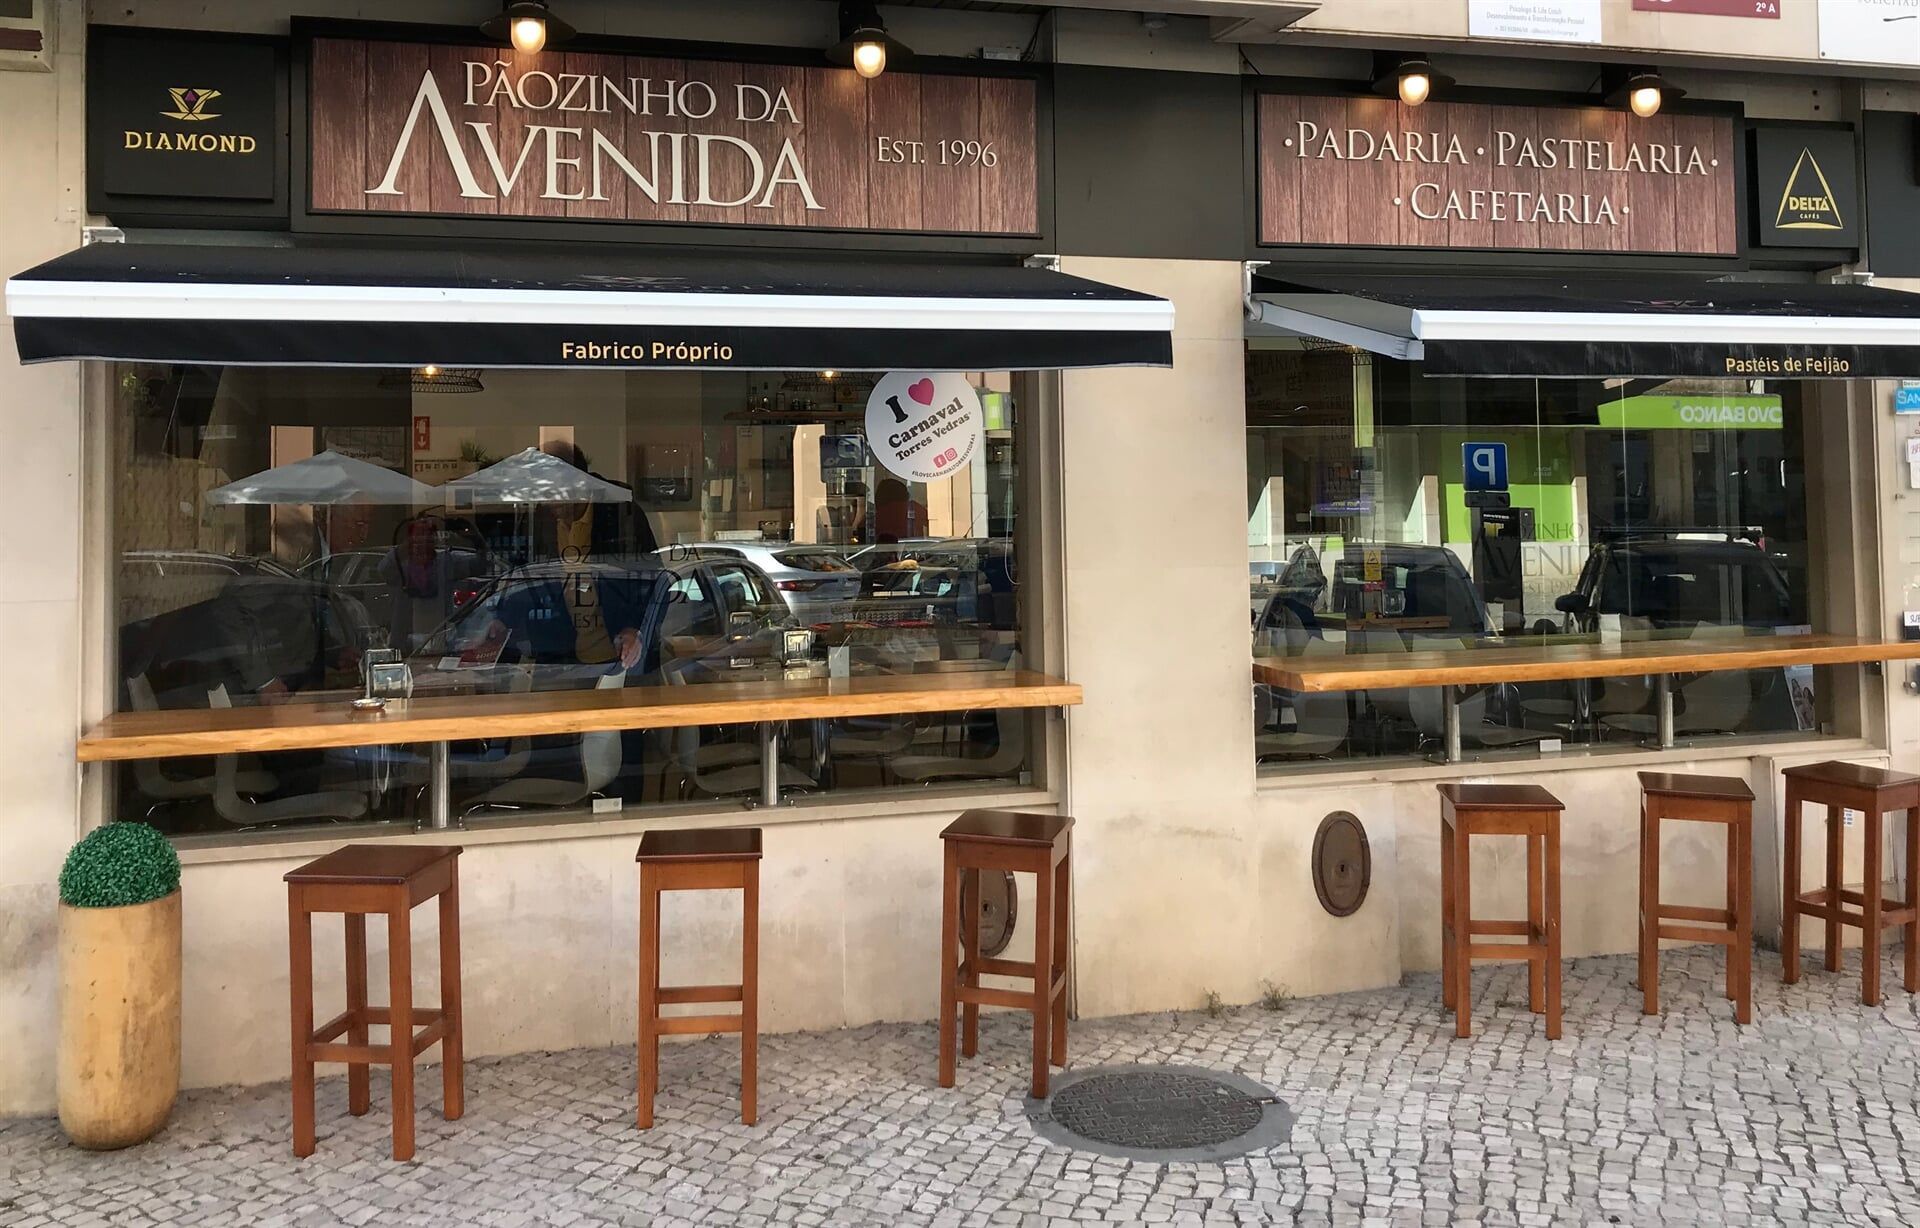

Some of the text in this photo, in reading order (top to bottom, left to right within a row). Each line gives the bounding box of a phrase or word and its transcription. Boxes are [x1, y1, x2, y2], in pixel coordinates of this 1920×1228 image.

[1768, 2, 1776, 13] A
[462, 60, 800, 124] PÃOZINHO DA
[124, 131, 256, 153] DIAMOND
[364, 69, 826, 210] AVENIDA
[877, 136, 997, 168] EST. 1996
[1295, 120, 1708, 177] PADARIA PASTELARIA
[1411, 182, 1618, 226] CAFETARIA
[1789, 196, 1831, 211] DELTA
[562, 341, 733, 363] Fabrico Próprio
[1725, 357, 1849, 374] Pastéis de Feijão
[885, 395, 909, 423] I
[888, 396, 964, 448] Carnaval
[895, 435, 933, 461] Torres
[669, 543, 701, 562] DA
